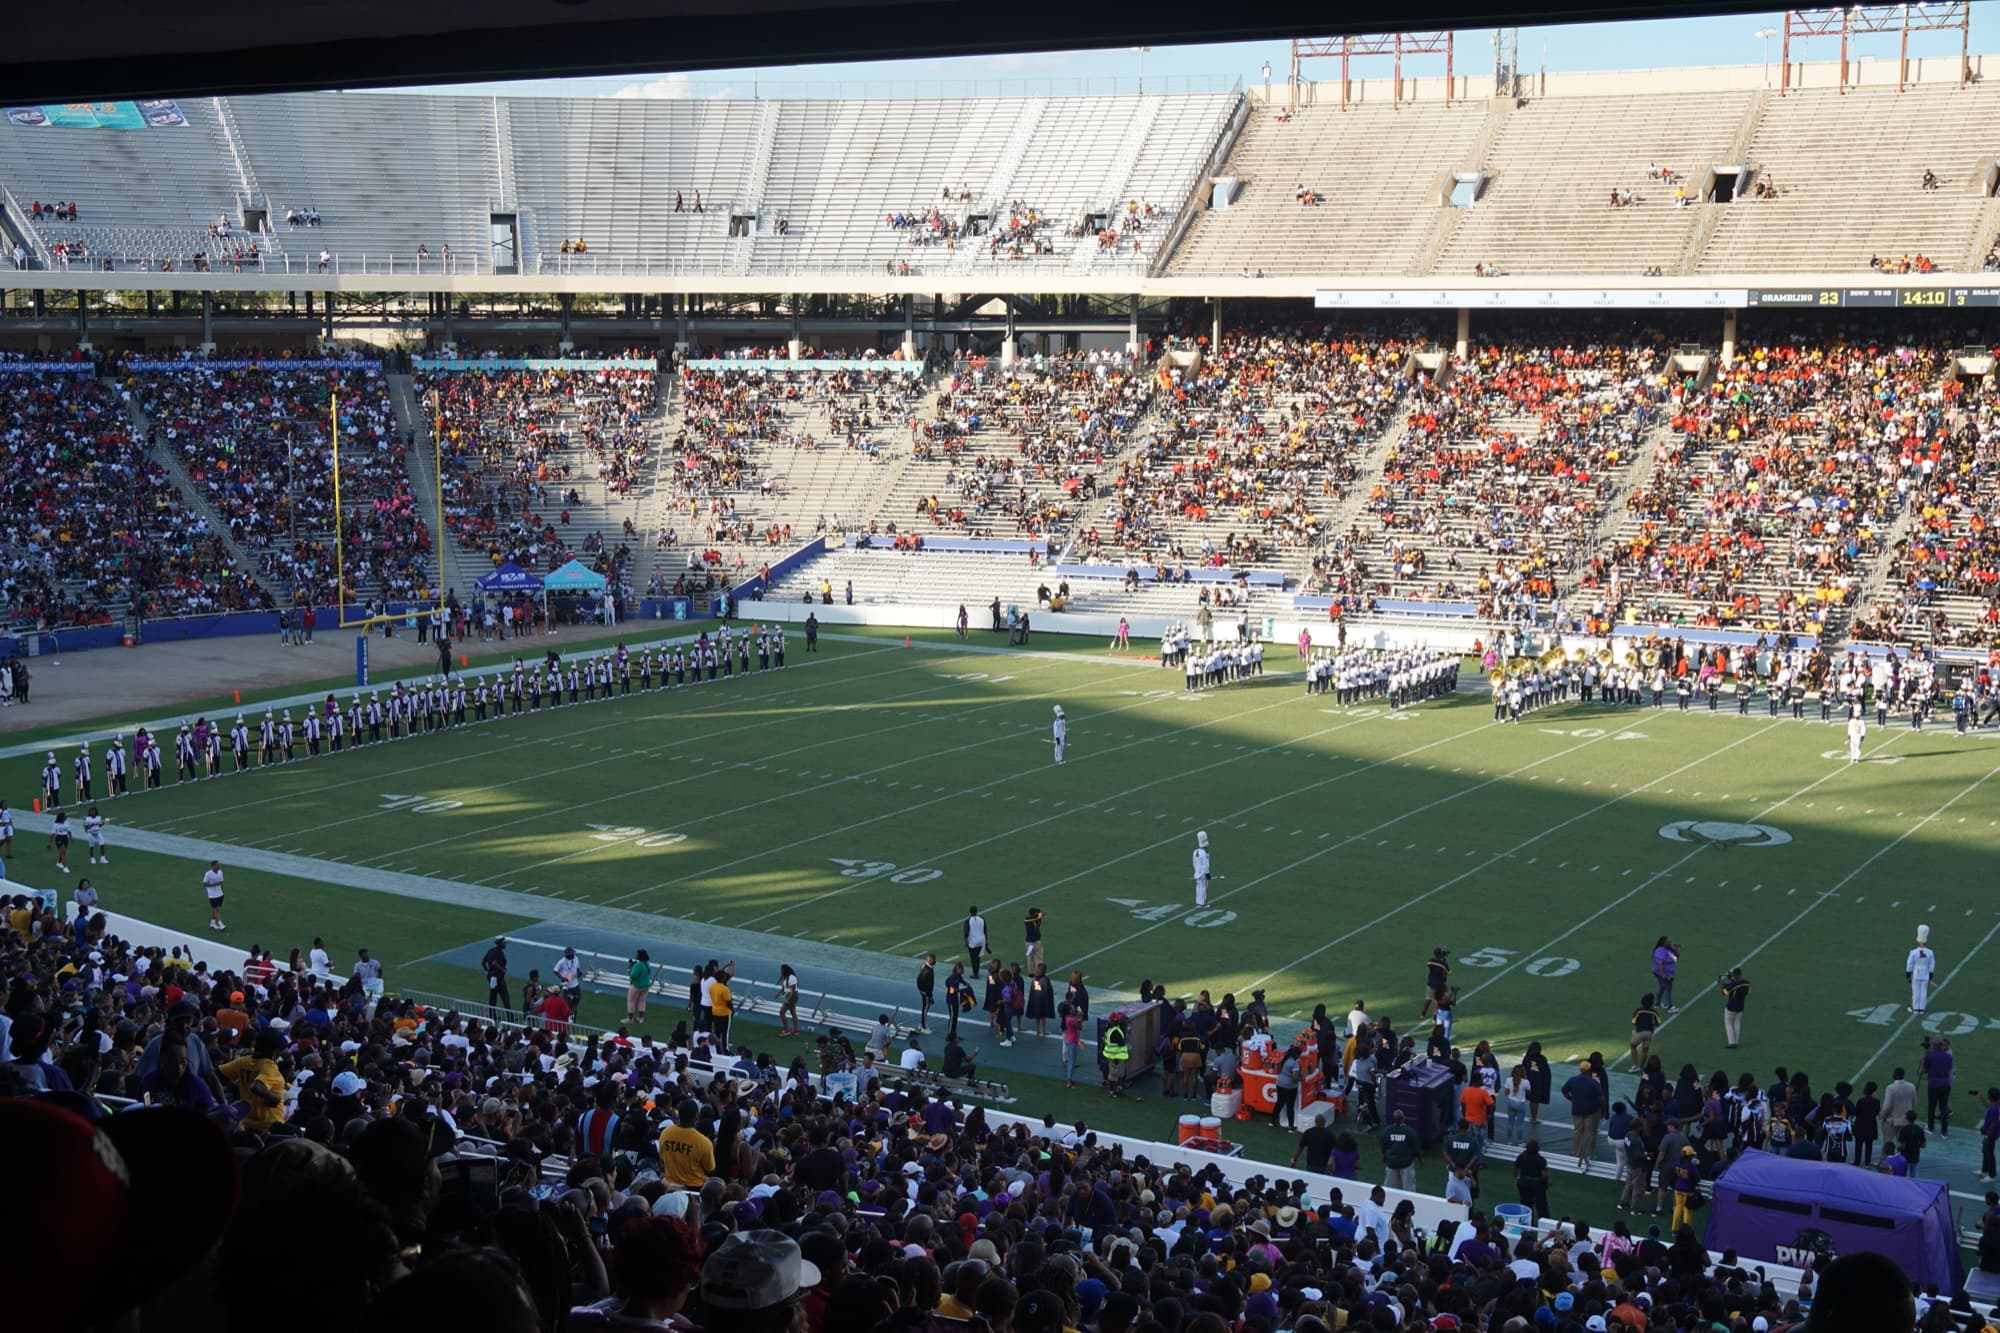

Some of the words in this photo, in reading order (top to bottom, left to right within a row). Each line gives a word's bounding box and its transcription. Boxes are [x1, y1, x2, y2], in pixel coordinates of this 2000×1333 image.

[1761, 293, 1814, 302] GRAMBLING
[1819, 291, 1839, 305] 23
[1903, 291, 1945, 305] 14:10
[1957, 296, 1965, 305] 3
[588, 826, 688, 847] 20
[838, 861, 943, 884] 30
[1128, 903, 1238, 928] 40
[1459, 946, 1581, 977] 50
[1846, 1003, 1980, 1035] 40
[1262, 1083, 1278, 1103] G
[1389, 1133, 1407, 1142] STAFF
[1452, 1141, 1471, 1150] STAFF
[664, 1140, 694, 1156] STAFF
